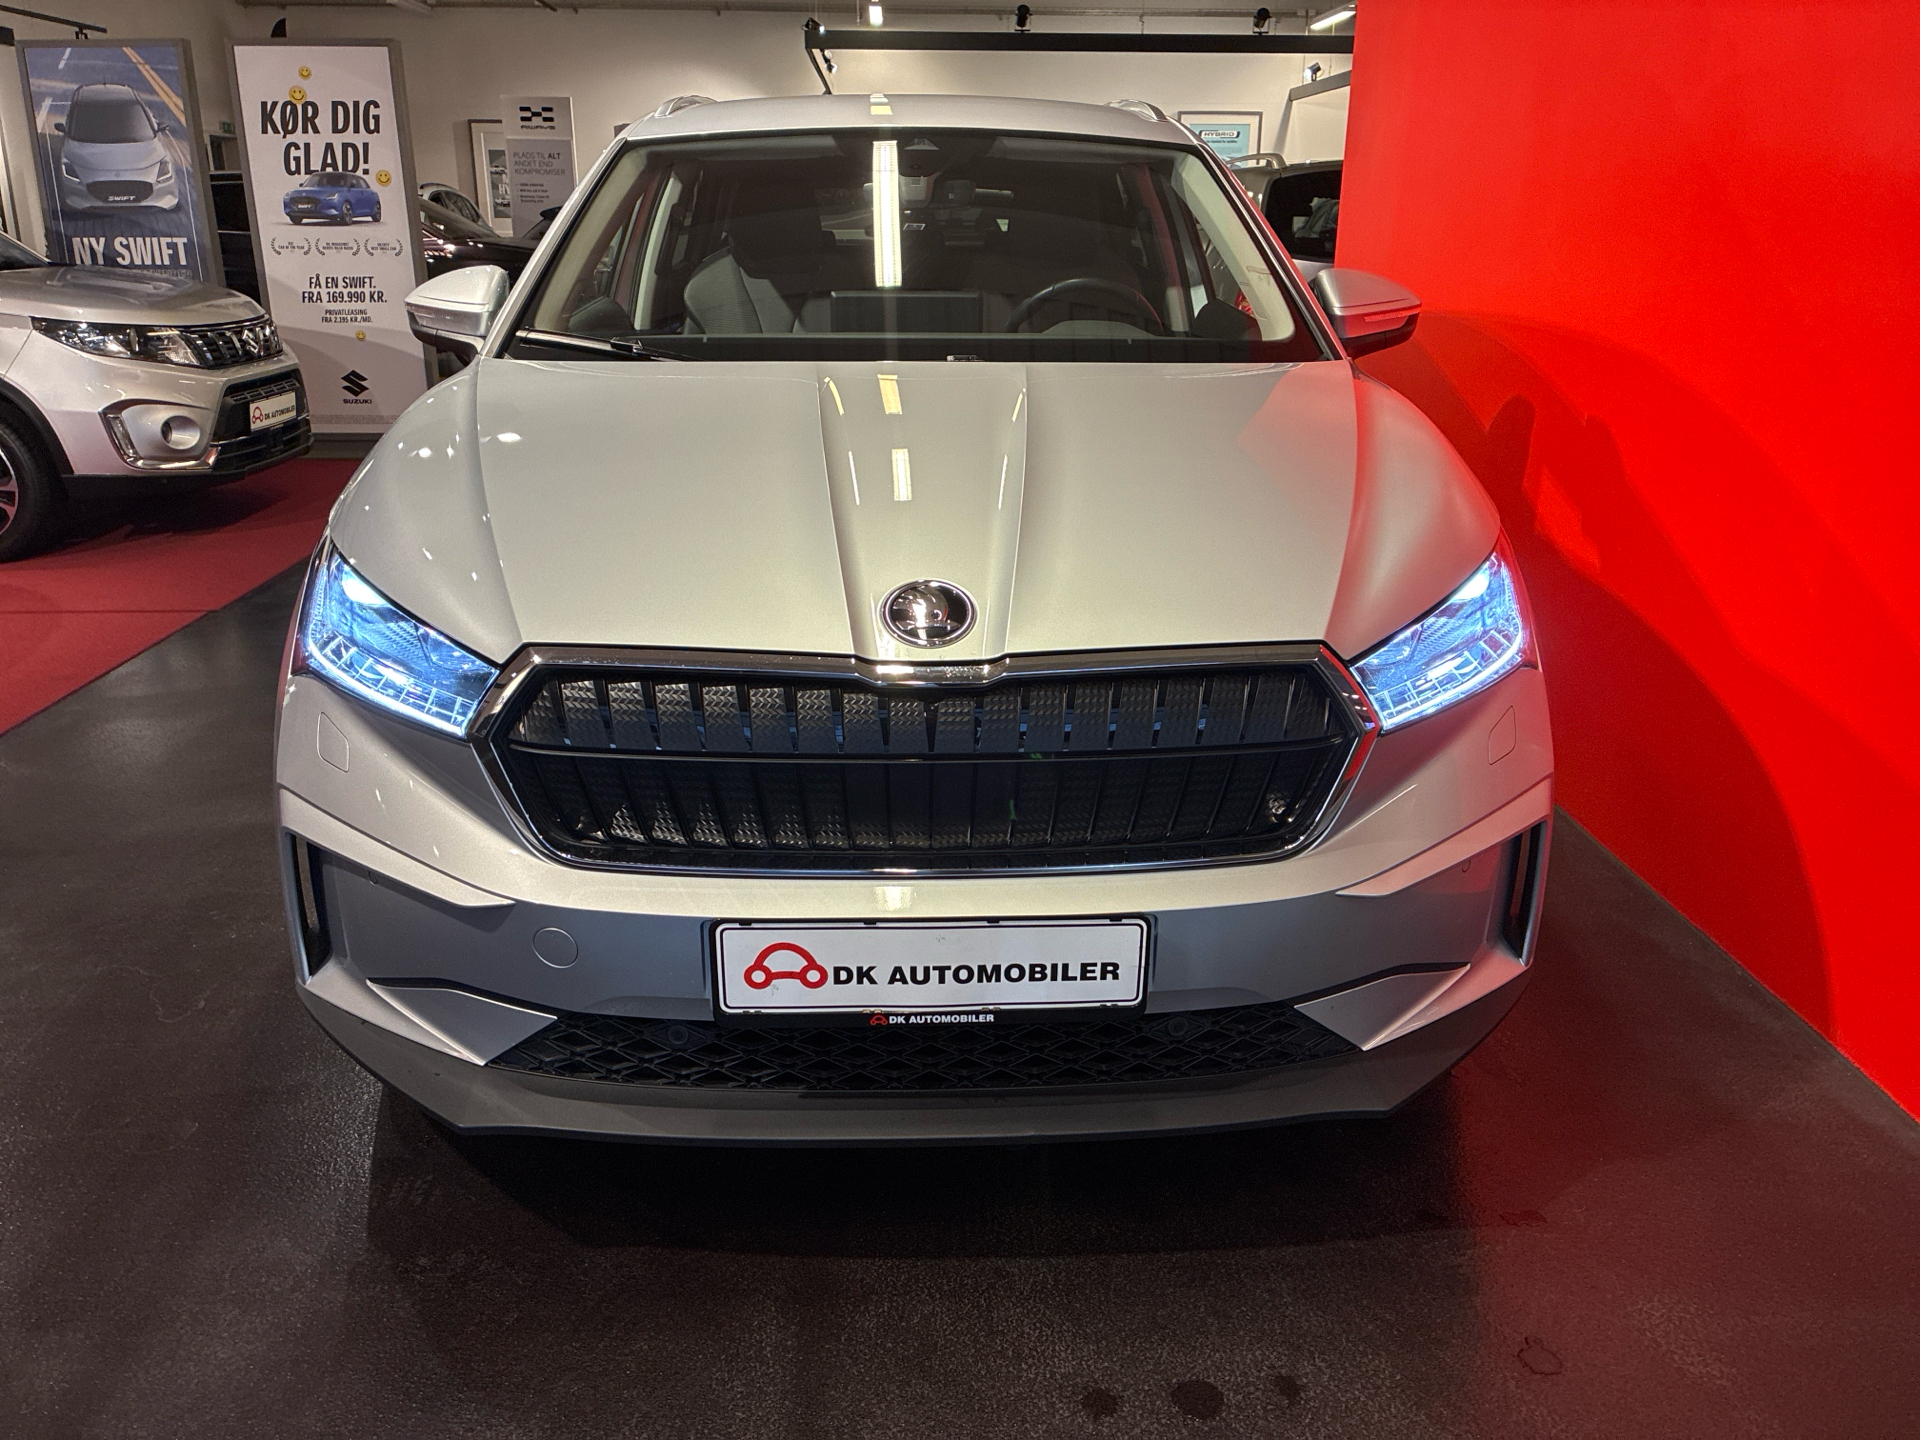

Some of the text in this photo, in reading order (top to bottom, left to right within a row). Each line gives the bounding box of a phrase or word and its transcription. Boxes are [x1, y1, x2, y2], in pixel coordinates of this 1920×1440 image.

[260, 99, 381, 139] KØR DIG
[283, 141, 370, 176] GLAD!
[513, 151, 561, 160] PLADS TIL ALT
[514, 168, 566, 176] KOMPROMISER
[71, 236, 188, 266] NY SWIFT
[308, 273, 377, 289] FÅ EN SWIFT.
[301, 290, 388, 304] FRA 169.990 KR.
[324, 308, 368, 316] PRIVATLEASING
[321, 316, 333, 324] FRA
[333, 316, 349, 324] 2.195
[832, 961, 1121, 986] DK AUTOMOBILER
[889, 1014, 995, 1025] DK AUTOMOBILER
